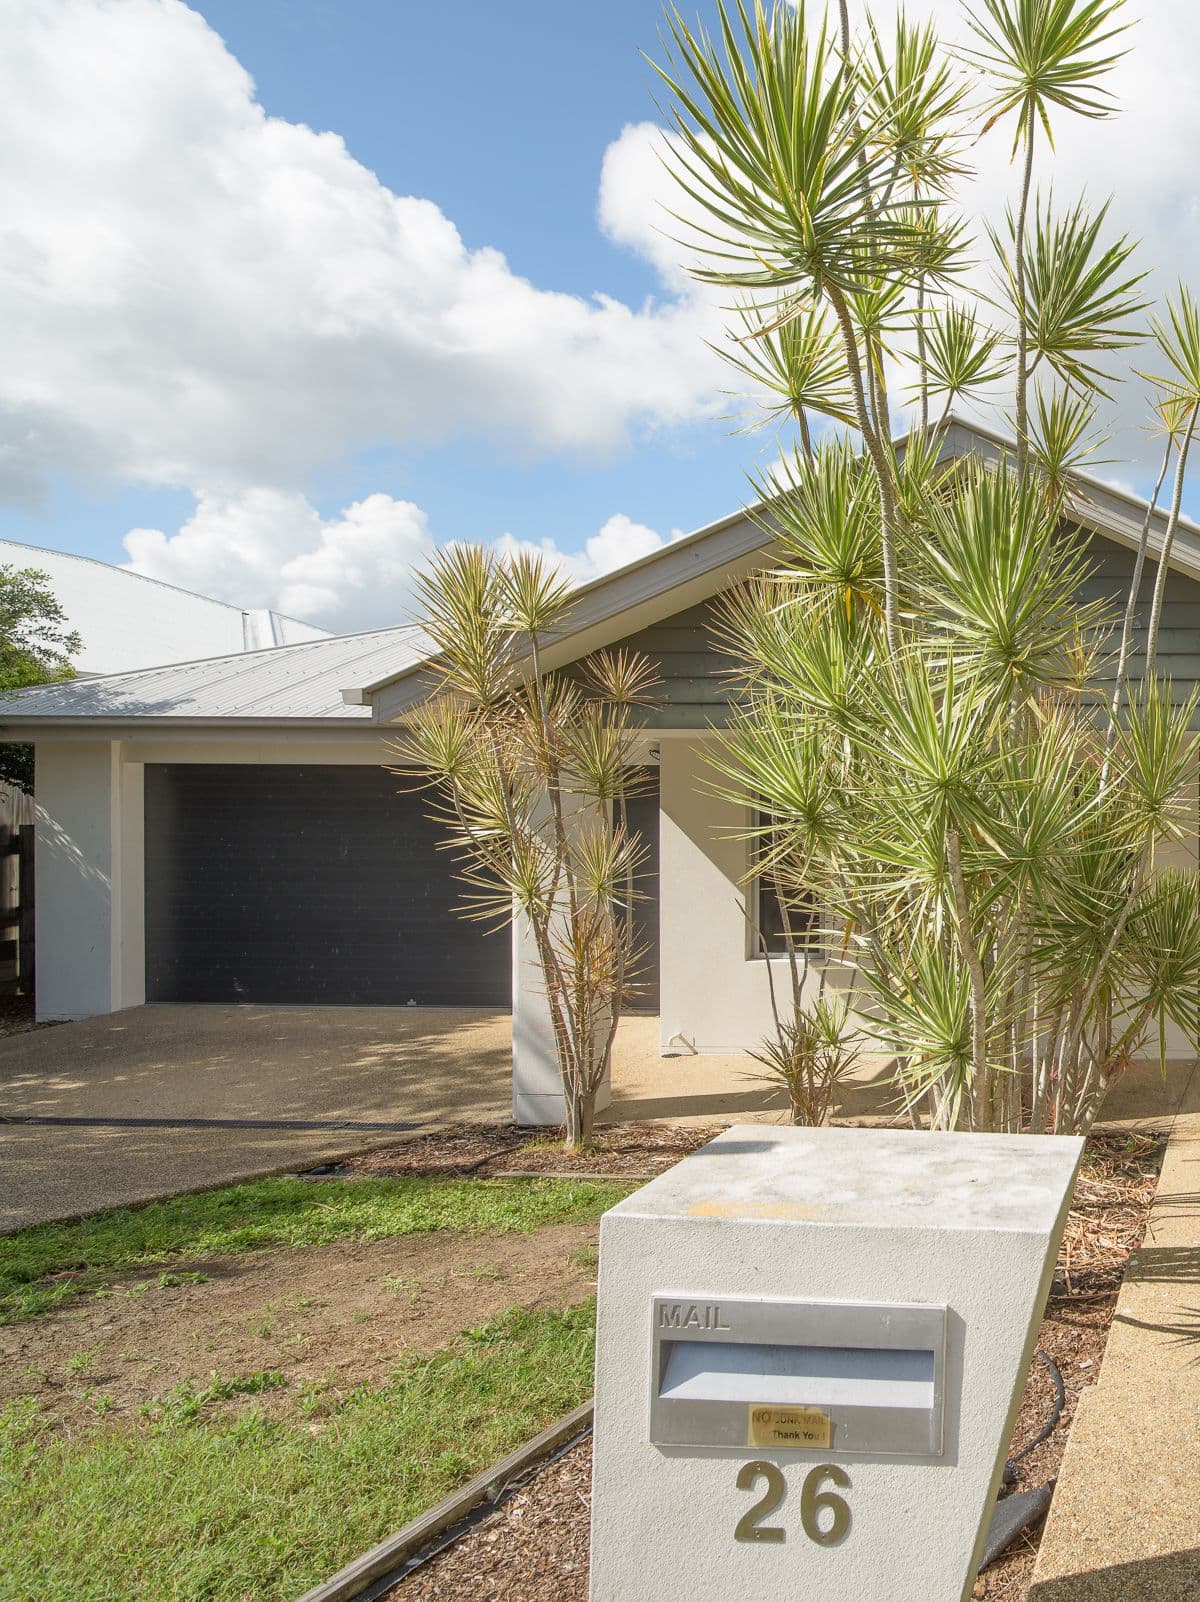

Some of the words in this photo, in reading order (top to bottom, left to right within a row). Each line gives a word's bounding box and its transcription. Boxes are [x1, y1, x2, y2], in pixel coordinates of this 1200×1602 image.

[659, 1303, 731, 1331] MAIL
[752, 1410, 771, 1424] NO
[772, 1430, 800, 1440] Thank
[734, 1460, 853, 1548] 26
